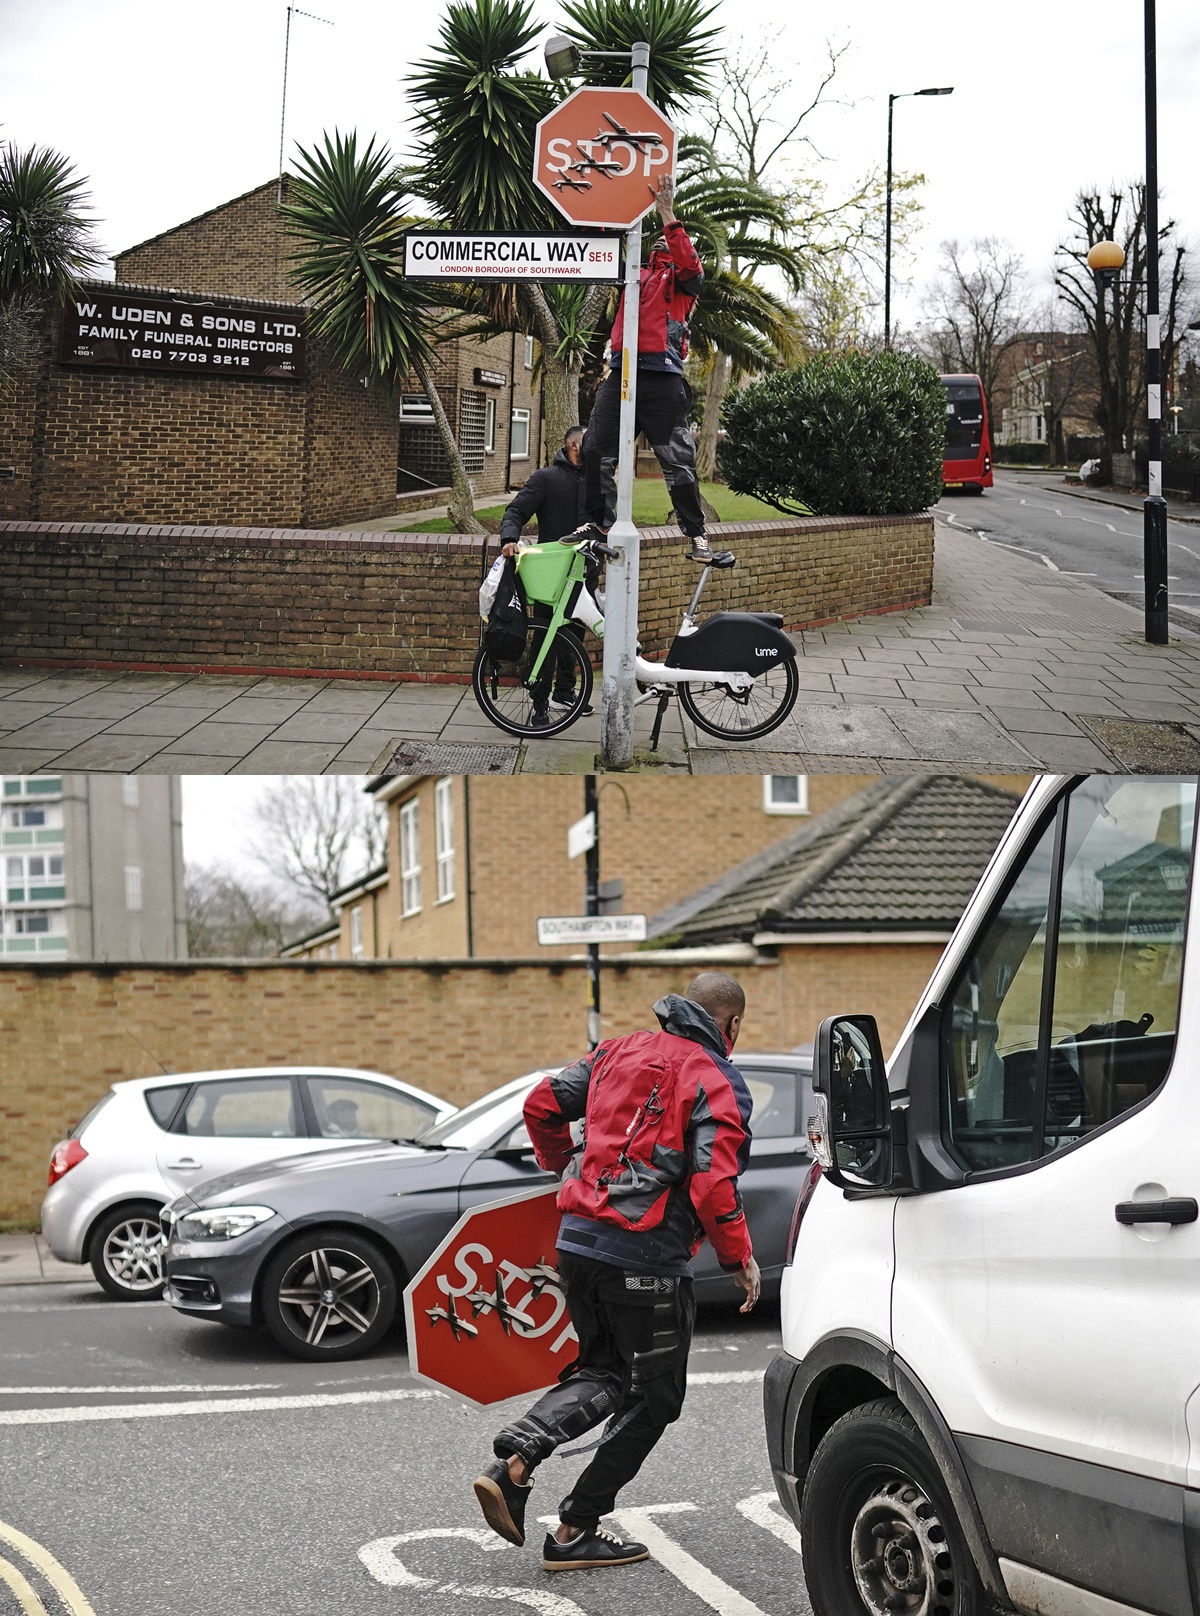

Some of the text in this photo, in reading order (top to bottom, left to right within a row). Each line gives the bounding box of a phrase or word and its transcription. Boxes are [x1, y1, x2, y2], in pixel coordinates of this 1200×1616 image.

[545, 137, 669, 177] STOP
[412, 240, 613, 263] COMMERCIAL WAY SE15
[440, 265, 473, 273] LONDON
[475, 266, 515, 274] BOROUGH
[530, 267, 581, 275] SOUTHWARK
[76, 302, 301, 338] W. UDEN & SONS LTD.
[79, 325, 293, 354] FAMILY FUNERAL DIRECTORS
[131, 348, 250, 366] 020 7703 3212
